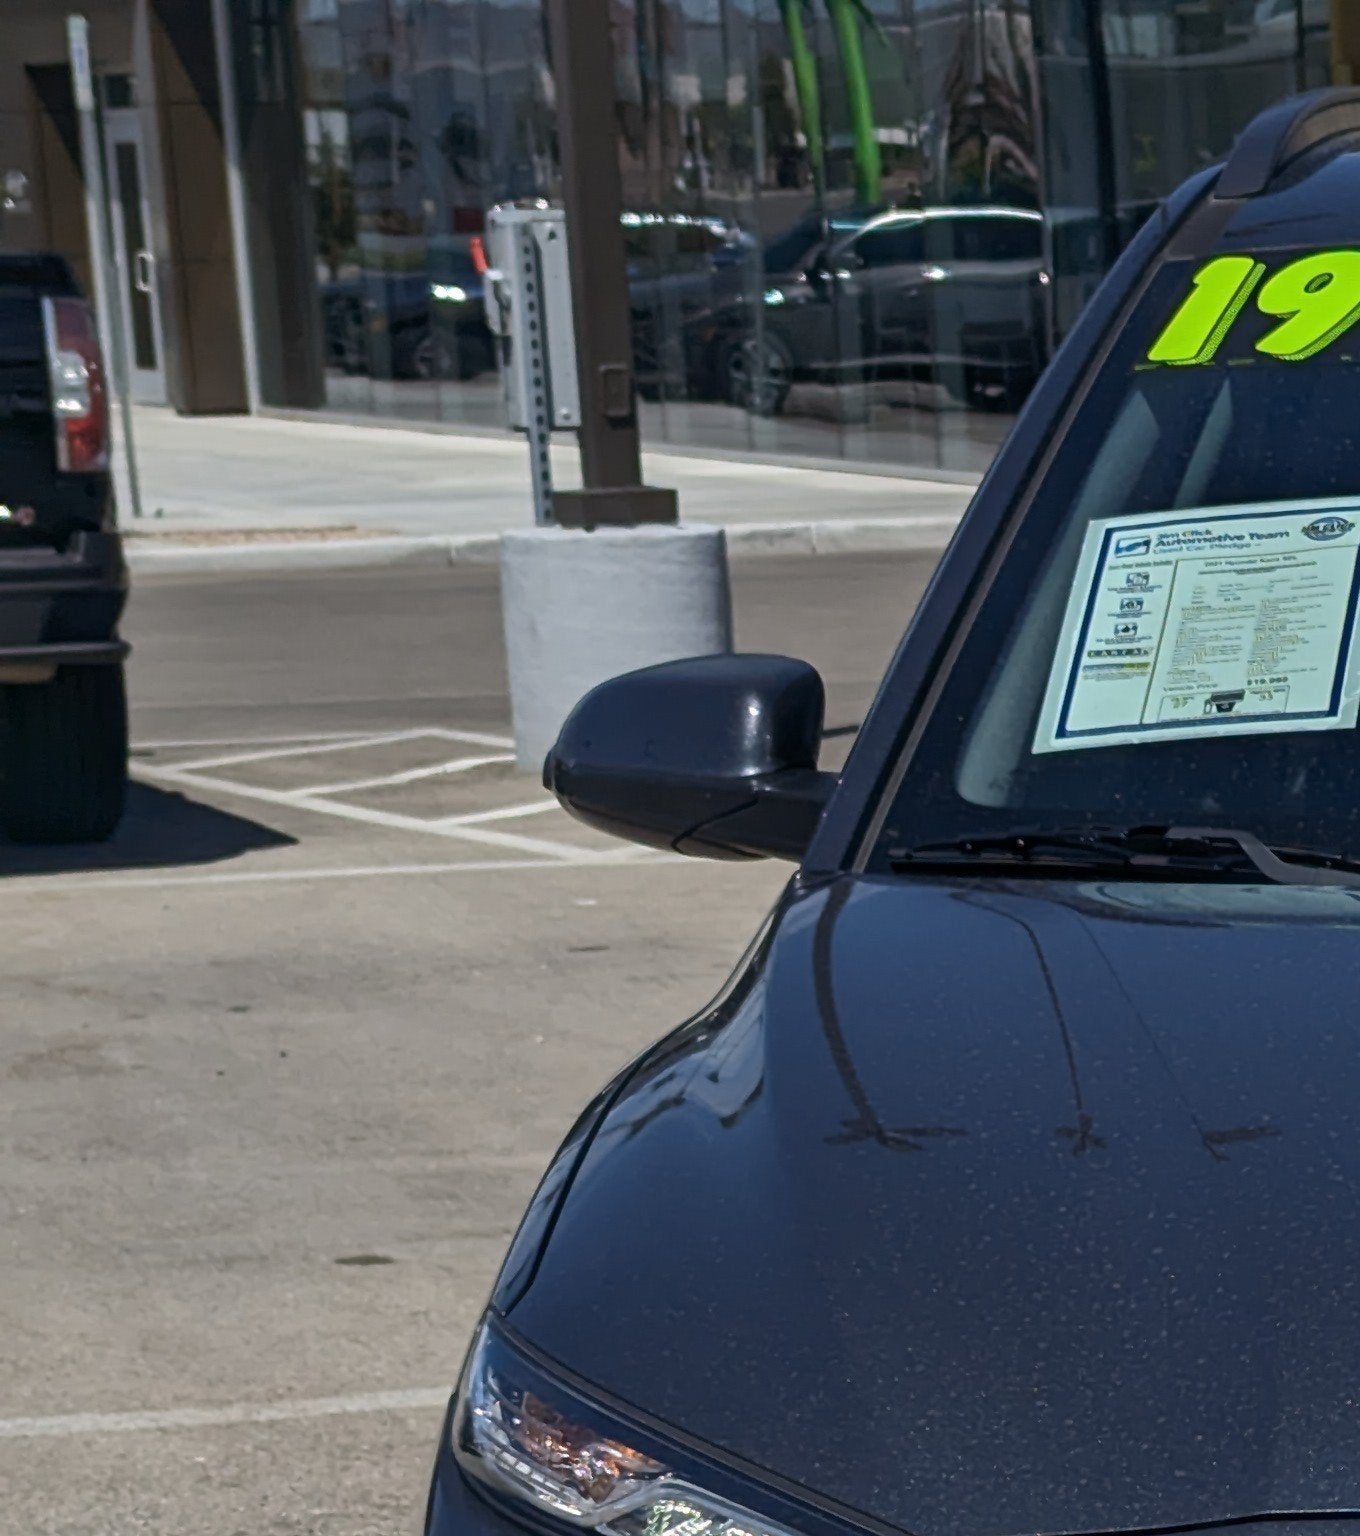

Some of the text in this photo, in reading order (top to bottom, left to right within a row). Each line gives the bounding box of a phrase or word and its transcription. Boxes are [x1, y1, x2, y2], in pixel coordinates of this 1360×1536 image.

[1155, 530, 1290, 546] Automotive Team
[1182, 529, 1213, 538] Click
